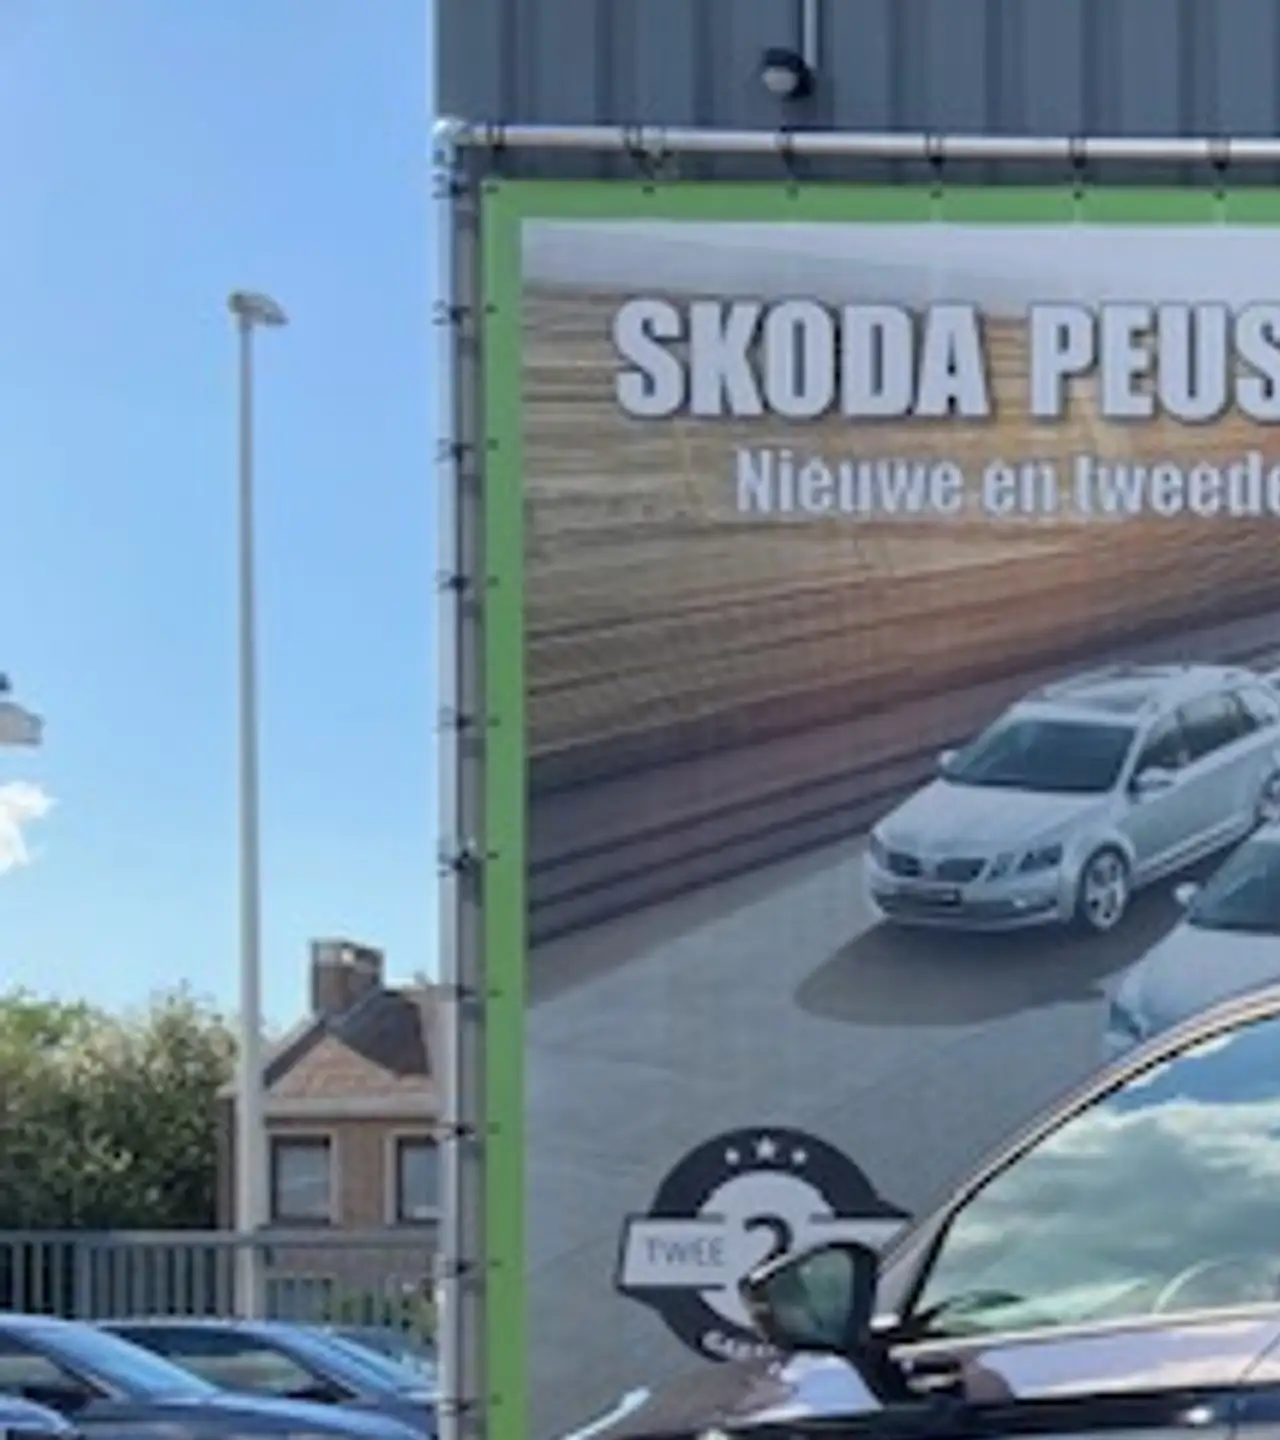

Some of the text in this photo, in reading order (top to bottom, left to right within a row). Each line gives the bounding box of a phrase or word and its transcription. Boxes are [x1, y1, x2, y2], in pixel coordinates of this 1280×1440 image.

[612, 298, 990, 420] SKODA
[736, 448, 966, 516] Nieuwe
[982, 459, 1056, 516] en
